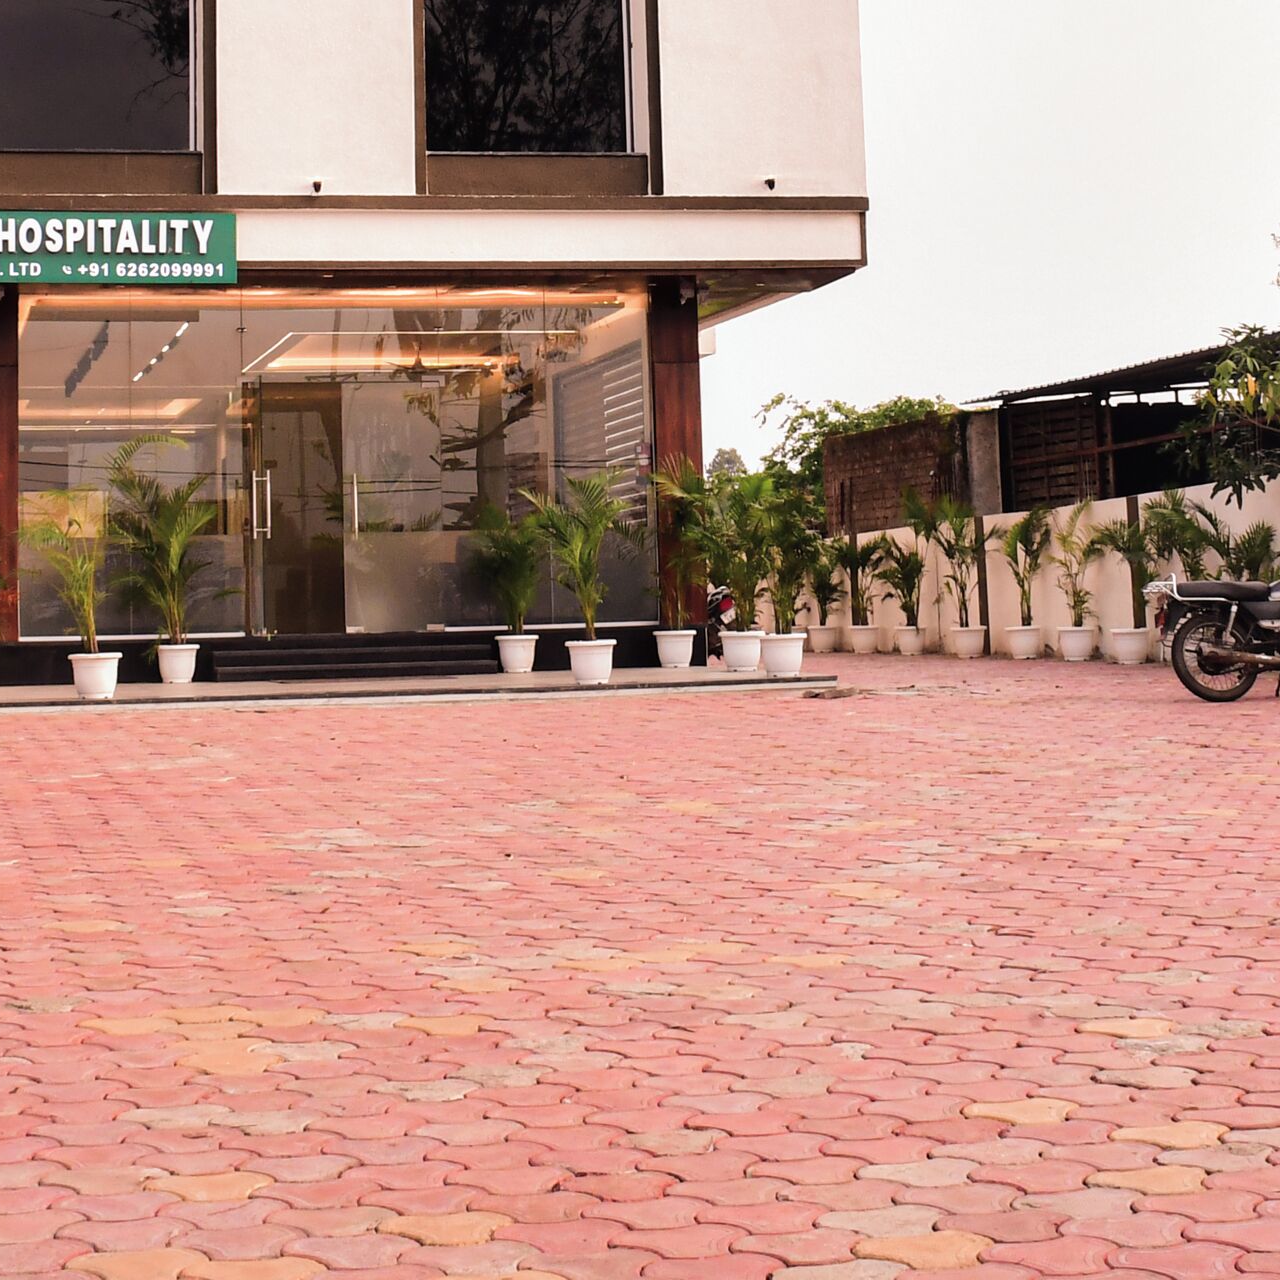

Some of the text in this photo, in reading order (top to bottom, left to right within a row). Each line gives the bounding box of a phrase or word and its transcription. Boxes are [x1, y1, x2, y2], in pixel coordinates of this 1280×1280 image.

[8, 262, 42, 277] LTD
[77, 262, 109, 277] +91
[115, 262, 224, 278] 6262099991
